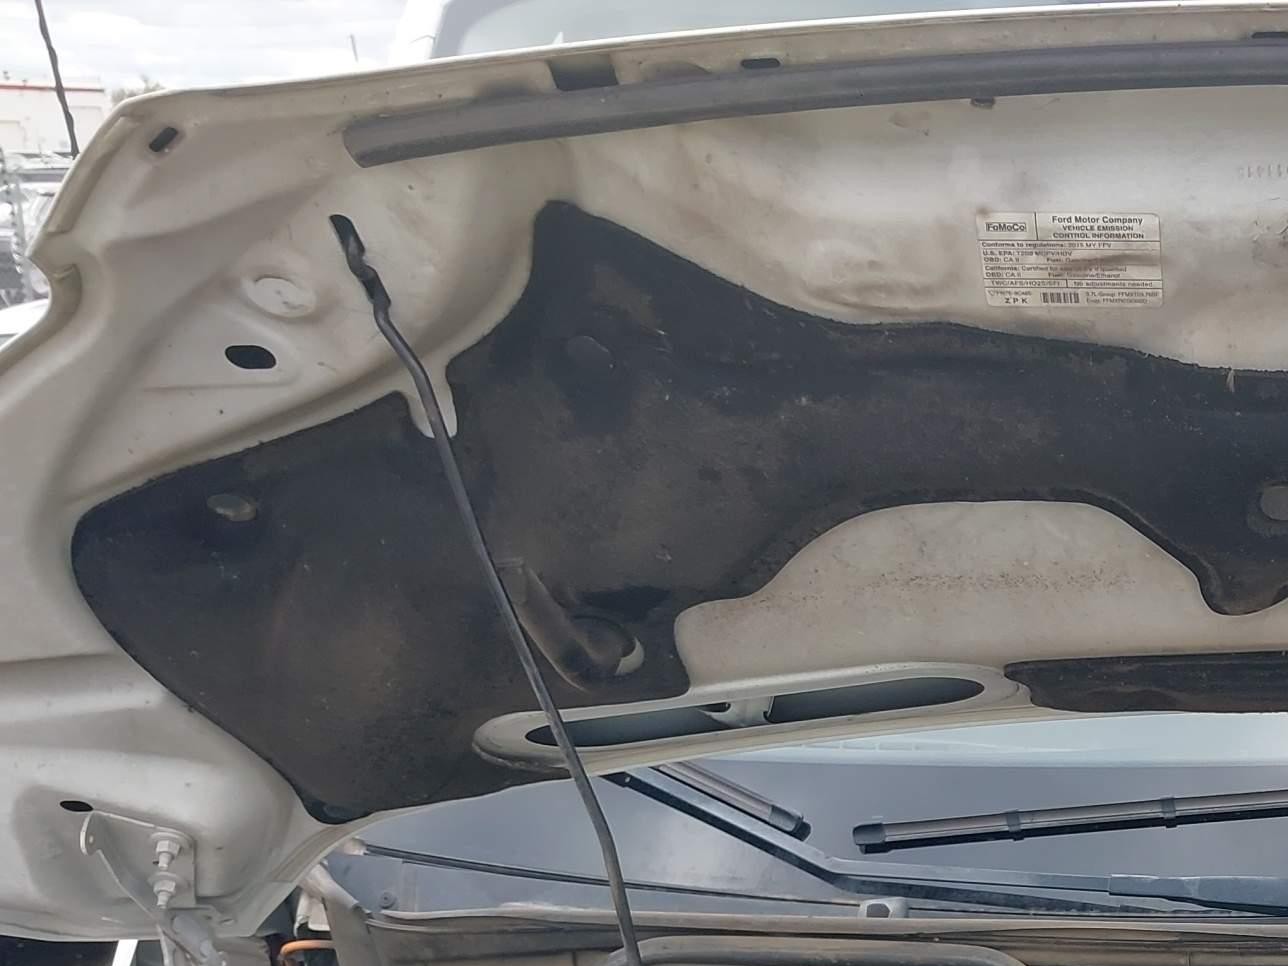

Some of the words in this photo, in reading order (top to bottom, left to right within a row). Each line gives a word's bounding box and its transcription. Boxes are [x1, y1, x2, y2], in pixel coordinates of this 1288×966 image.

[1052, 216, 1072, 224] Ford
[1075, 216, 1100, 224] Motor
[1102, 216, 1143, 225] Company
[987, 223, 1025, 232] FoMoCo
